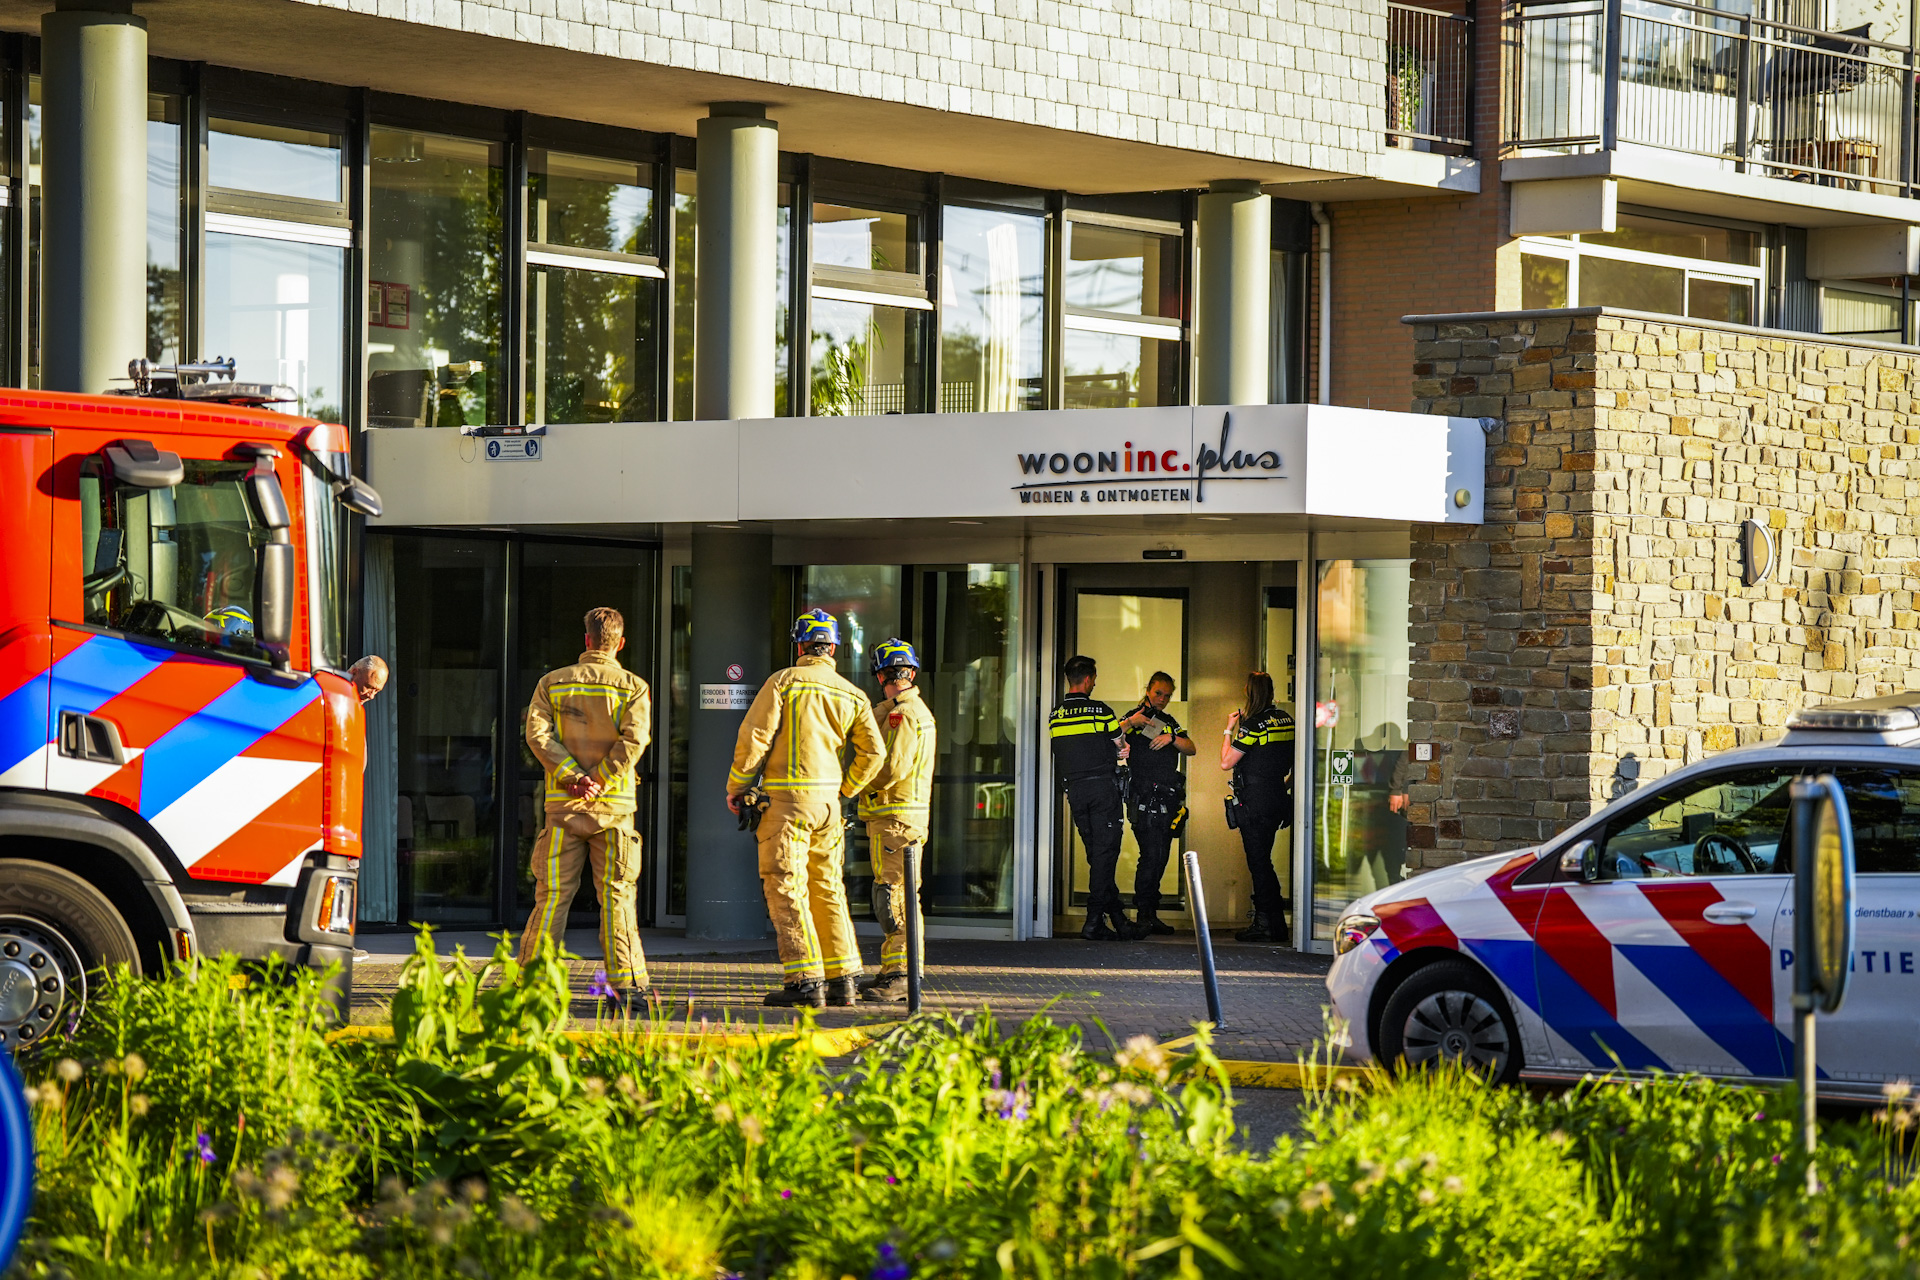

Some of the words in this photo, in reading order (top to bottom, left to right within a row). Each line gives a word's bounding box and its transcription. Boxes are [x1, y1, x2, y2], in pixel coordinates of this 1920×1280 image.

[1020, 490, 1073, 504] WONEN
[1080, 490, 1090, 503] &
[1097, 488, 1190, 502] ONTMOETEN
[1855, 906, 1906, 918] dienstbaar
